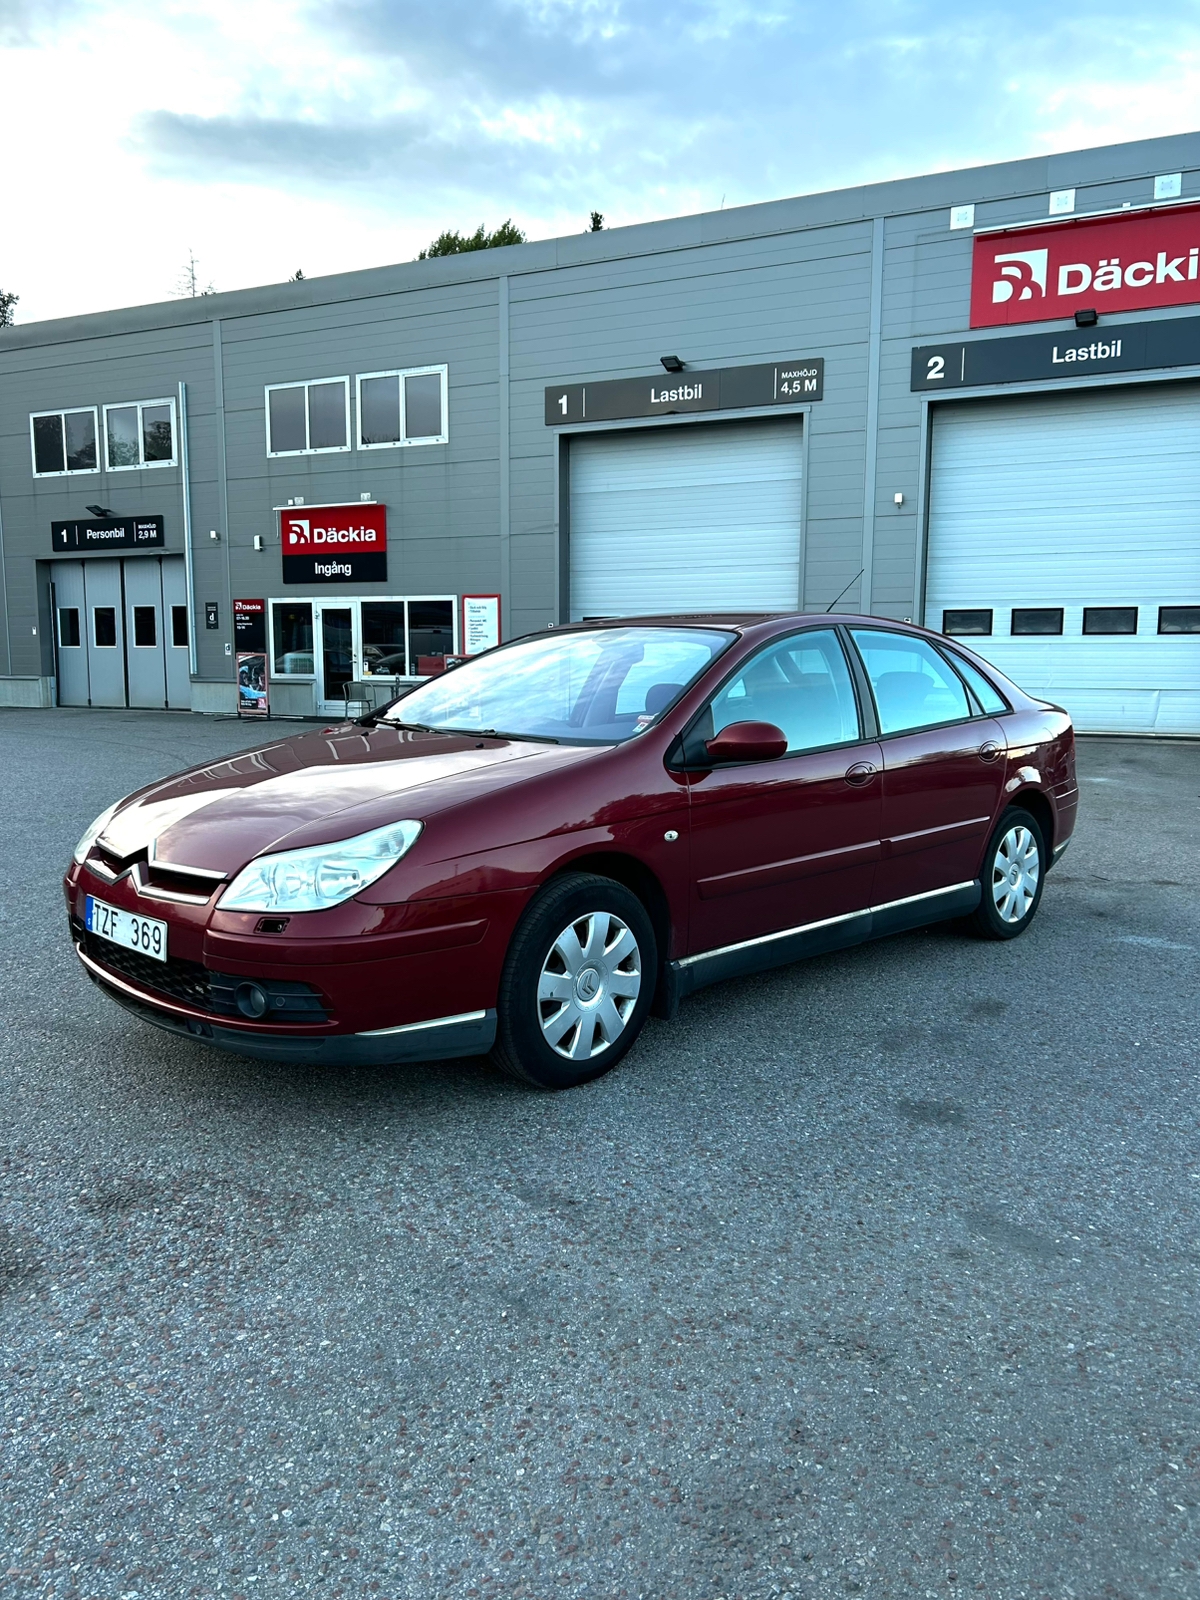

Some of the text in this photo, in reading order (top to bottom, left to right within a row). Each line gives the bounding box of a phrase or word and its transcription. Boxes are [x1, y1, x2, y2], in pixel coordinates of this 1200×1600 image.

[926, 340, 1122, 380] 2 Lastbil
[781, 369, 817, 379] MAXHÖJD
[781, 379, 817, 395] 4,5 M
[558, 384, 703, 415] 1 Lastbil
[61, 528, 125, 543] 1 Personbil
[138, 530, 157, 540] 2,9 M
[313, 526, 377, 543] Däckia
[314, 561, 352, 576] Ingång
[94, 903, 161, 955] TZF 369
